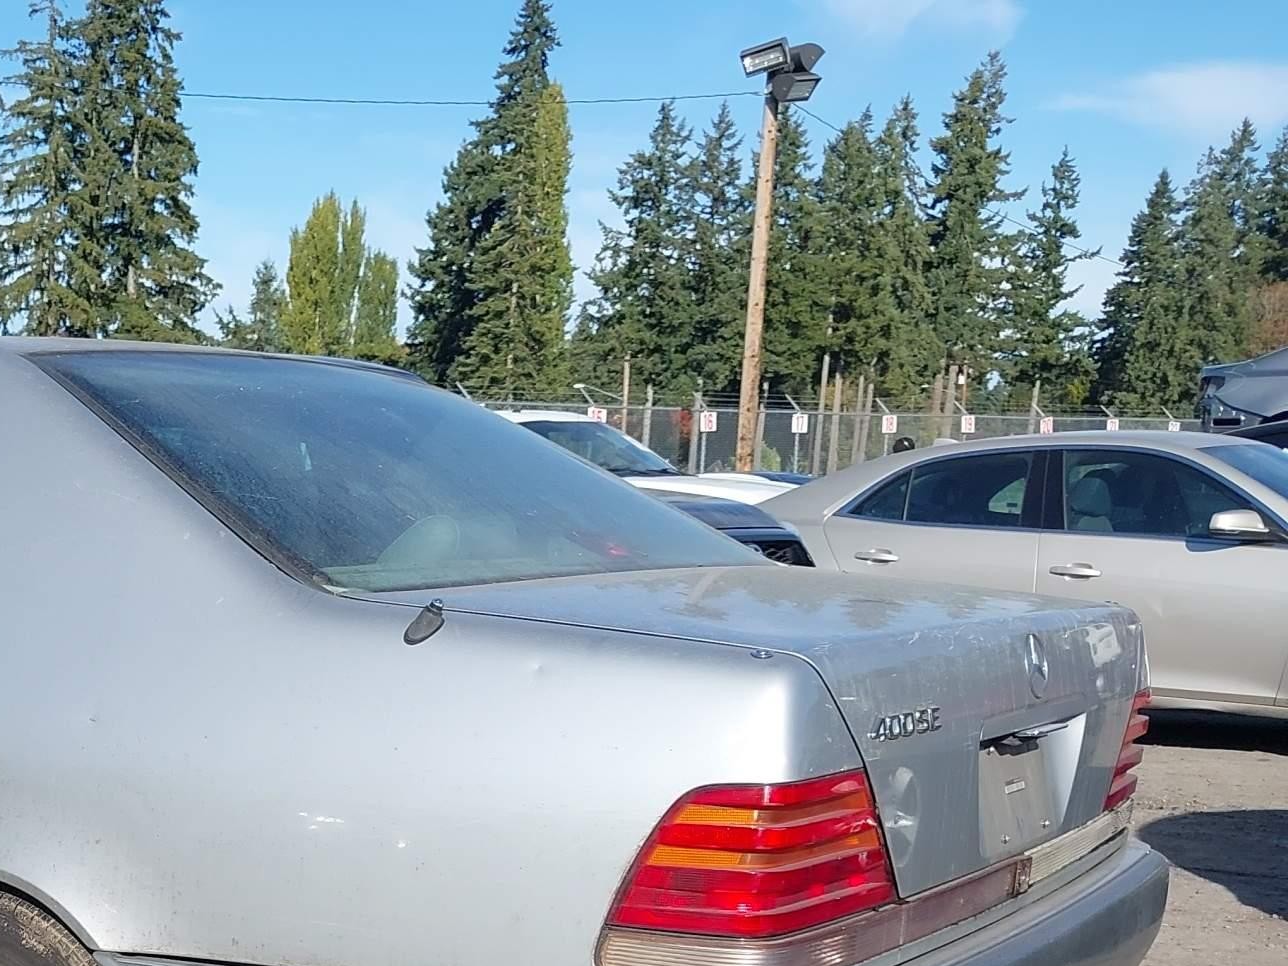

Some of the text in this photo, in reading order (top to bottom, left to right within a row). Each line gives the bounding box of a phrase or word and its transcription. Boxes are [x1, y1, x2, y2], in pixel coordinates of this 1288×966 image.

[704, 413, 713, 430] 16
[797, 415, 804, 432] 17
[867, 706, 942, 742] 400SE
